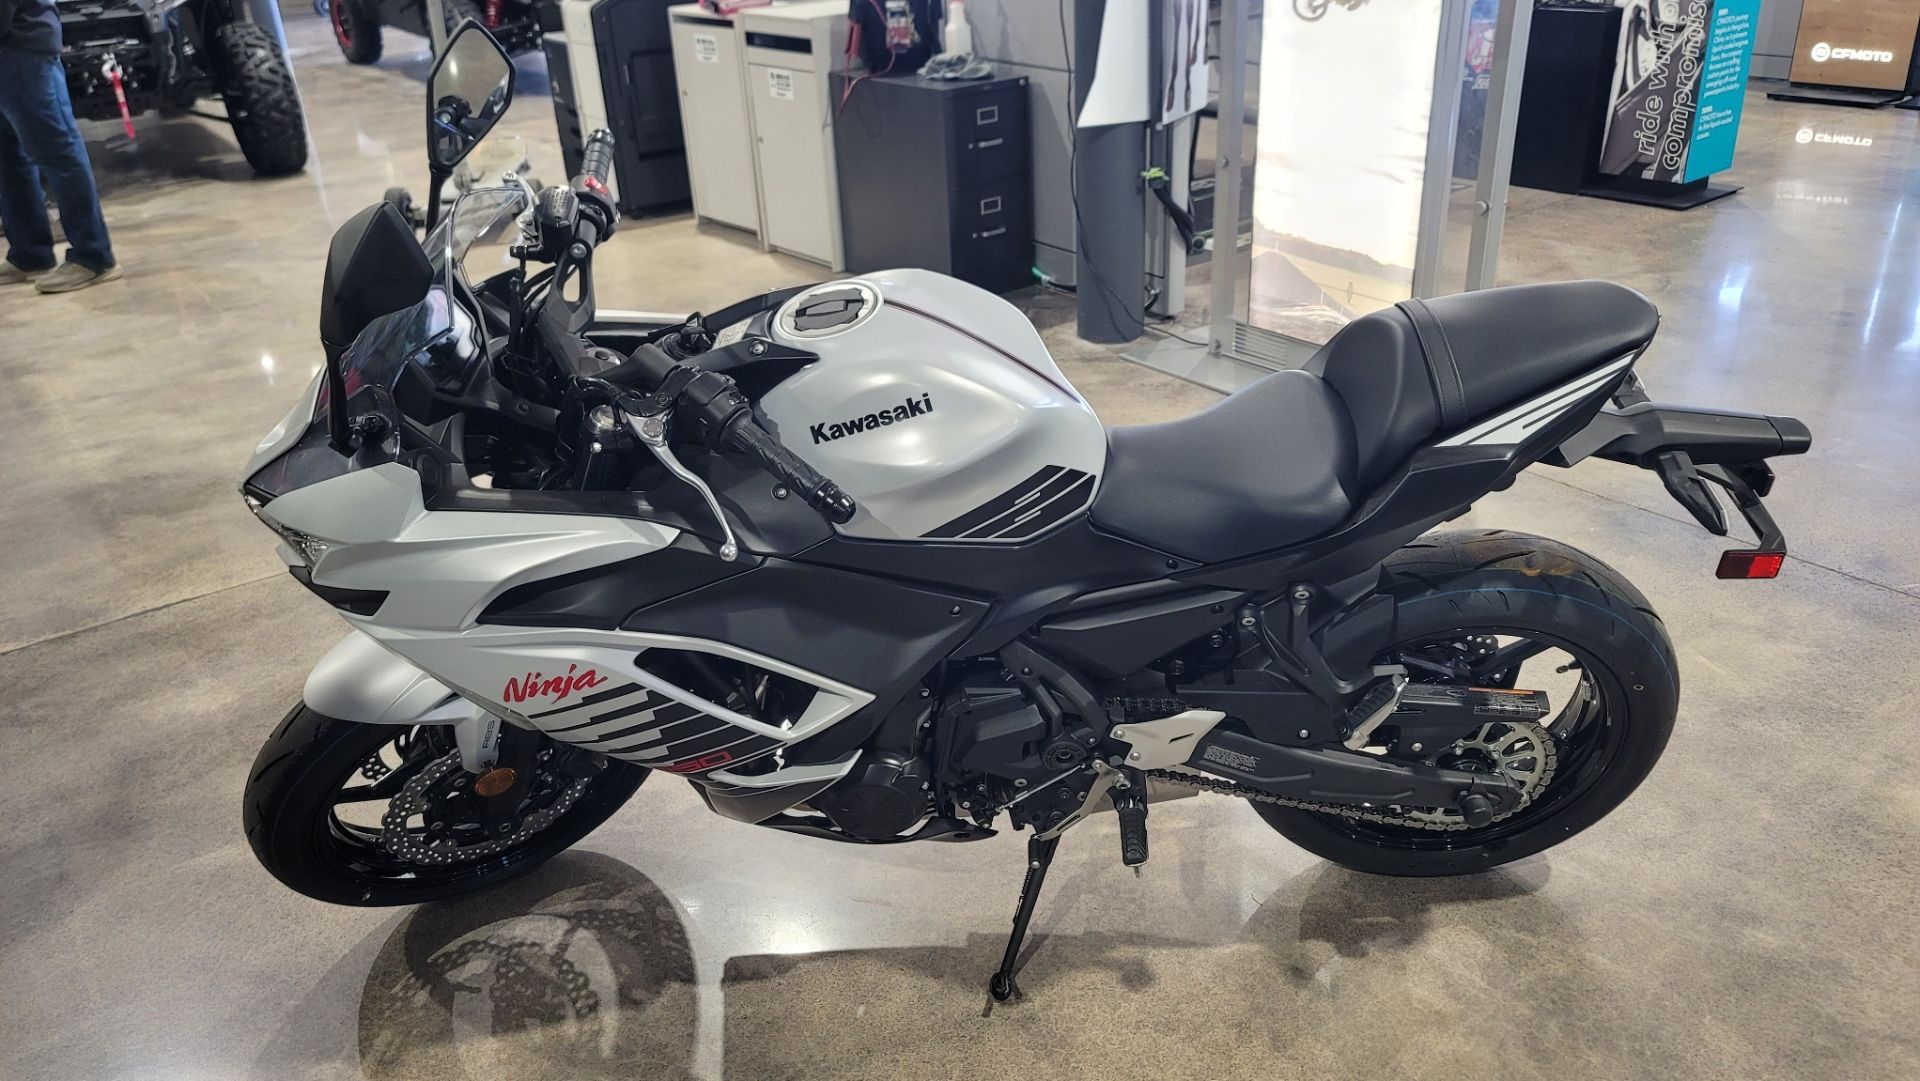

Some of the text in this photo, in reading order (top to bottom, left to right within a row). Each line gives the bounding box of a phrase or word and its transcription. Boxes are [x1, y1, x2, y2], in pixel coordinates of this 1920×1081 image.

[1831, 48, 1893, 62] CFMOTO
[1662, 0, 1708, 170] compromis
[1634, 95, 1664, 156] ride
[809, 392, 933, 445] Kawasaki
[503, 663, 608, 705] Ninja
[482, 719, 495, 749] ABS
